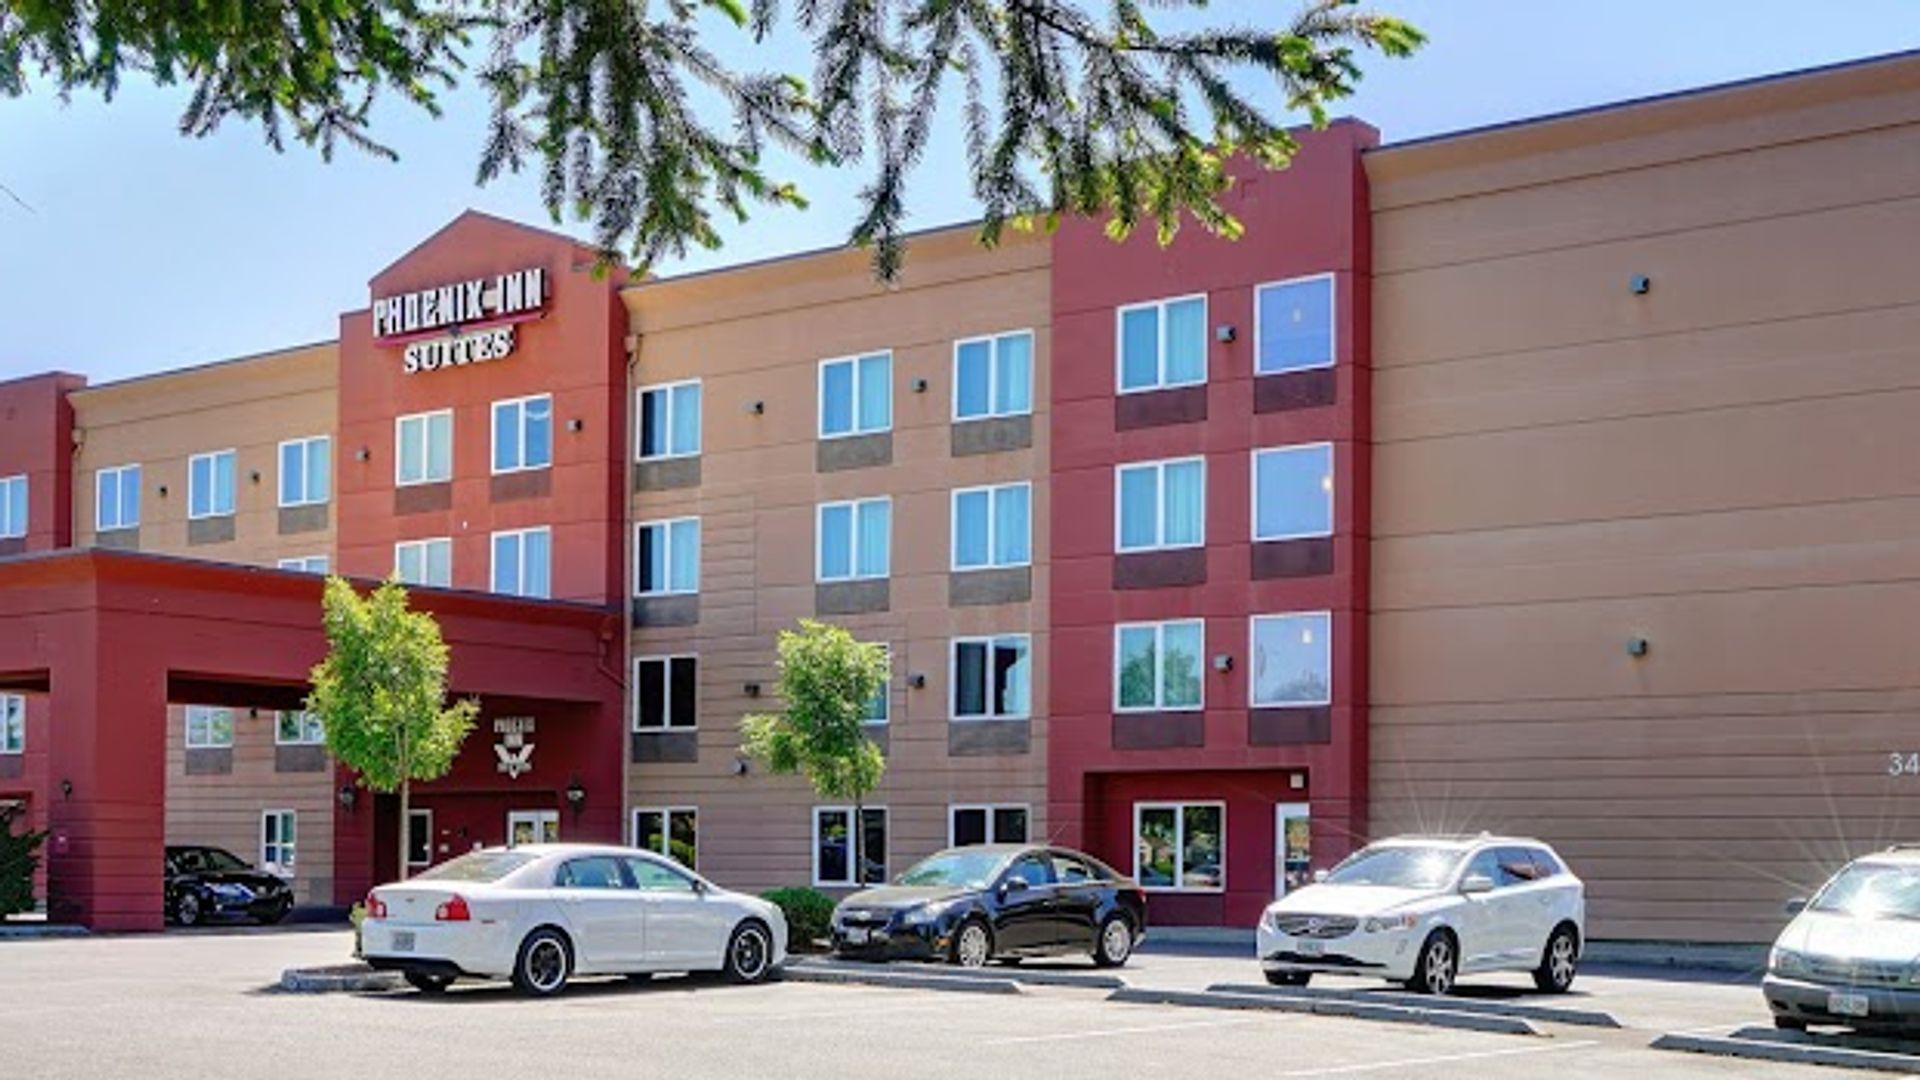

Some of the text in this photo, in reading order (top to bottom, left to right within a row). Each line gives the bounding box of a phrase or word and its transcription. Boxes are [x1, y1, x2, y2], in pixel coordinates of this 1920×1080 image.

[373, 268, 545, 338] PHOENIX INN
[404, 325, 515, 374] SUITES
